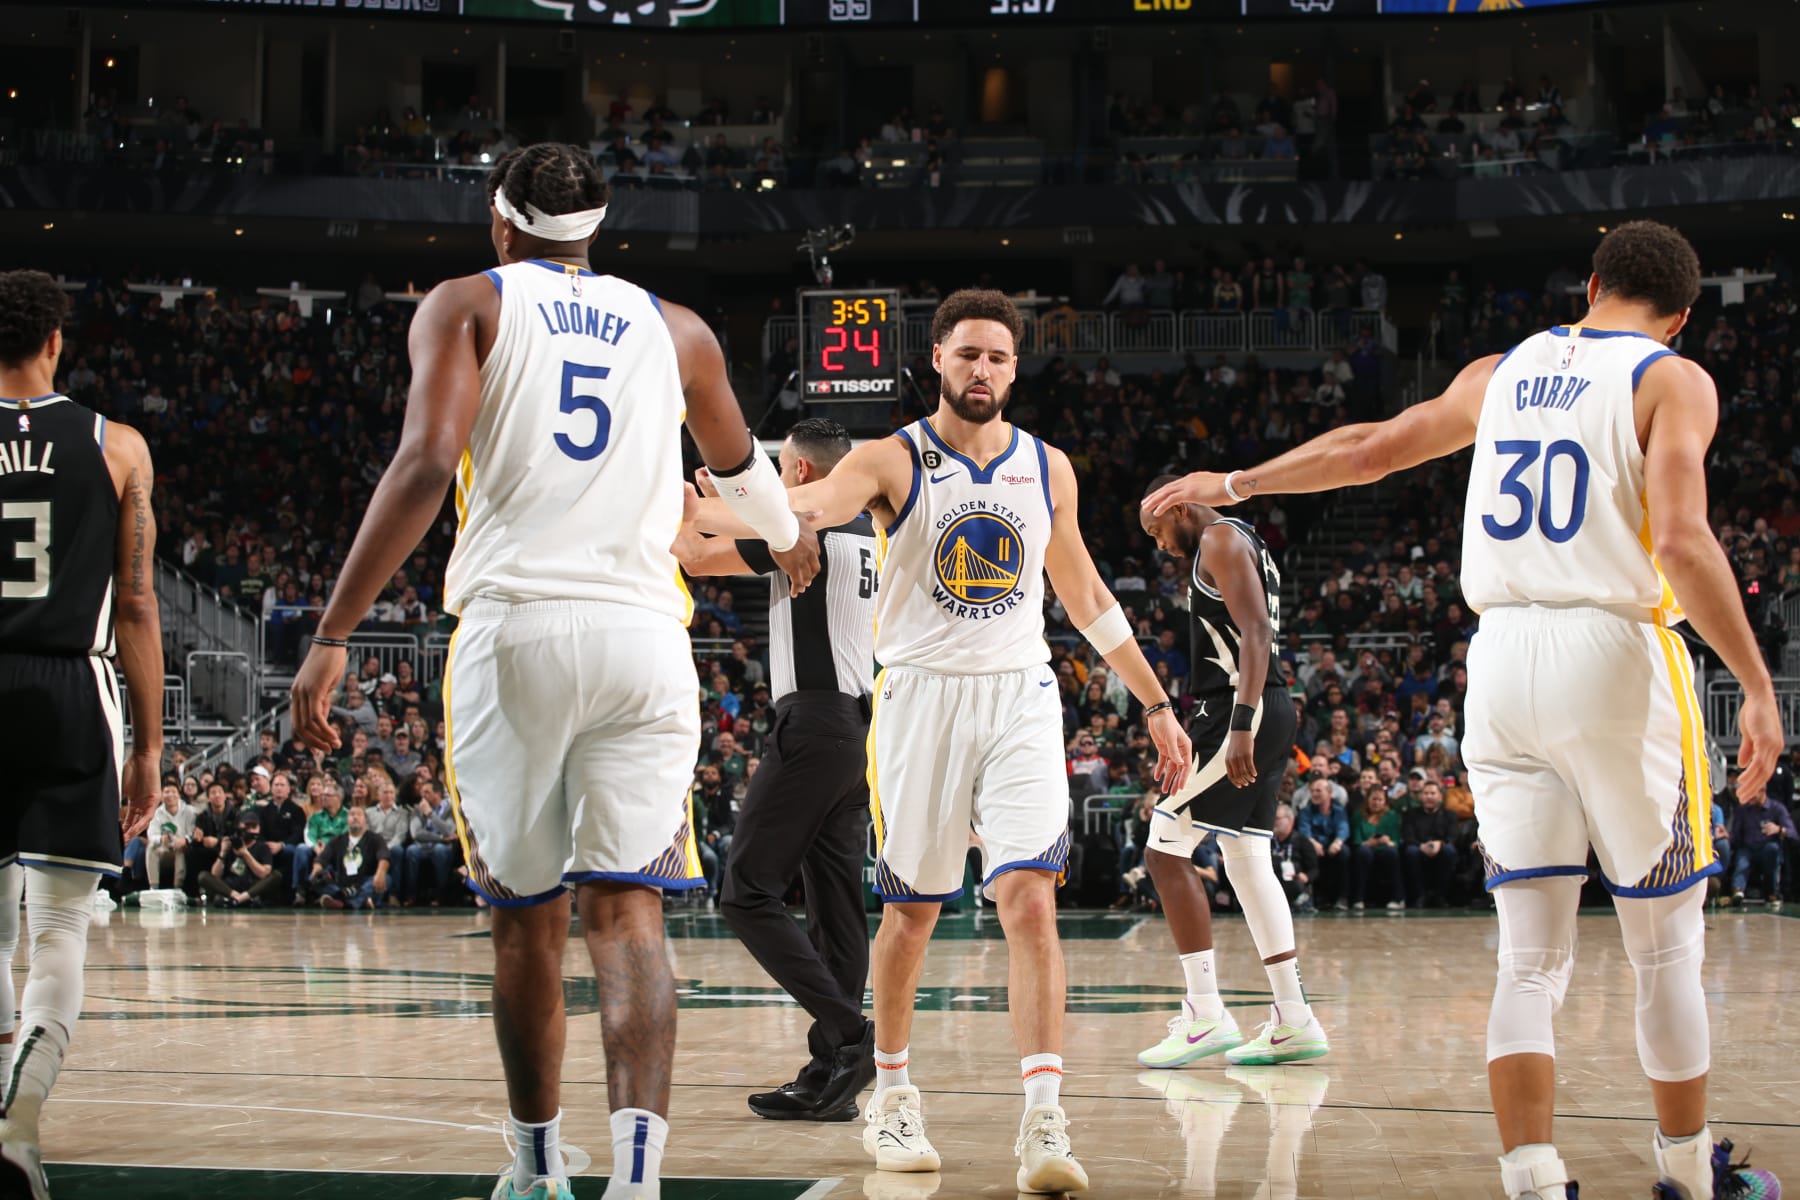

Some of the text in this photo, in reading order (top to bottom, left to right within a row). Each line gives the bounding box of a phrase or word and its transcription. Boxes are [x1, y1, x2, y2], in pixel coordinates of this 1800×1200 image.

[538, 300, 631, 346] LOONEY
[832, 299, 887, 325] 3:57
[821, 327, 880, 371] 24
[831, 379, 894, 393] TISSOT
[1516, 375, 1591, 412] CURRY
[553, 360, 611, 461] 5
[1001, 474, 1035, 485] Rakuten
[1481, 439, 1590, 544] 30
[936, 501, 1027, 532] GOLDEN STATE
[2, 502, 51, 598] 3
[859, 548, 879, 599] 5
[932, 584, 1025, 620] WARRIORS
